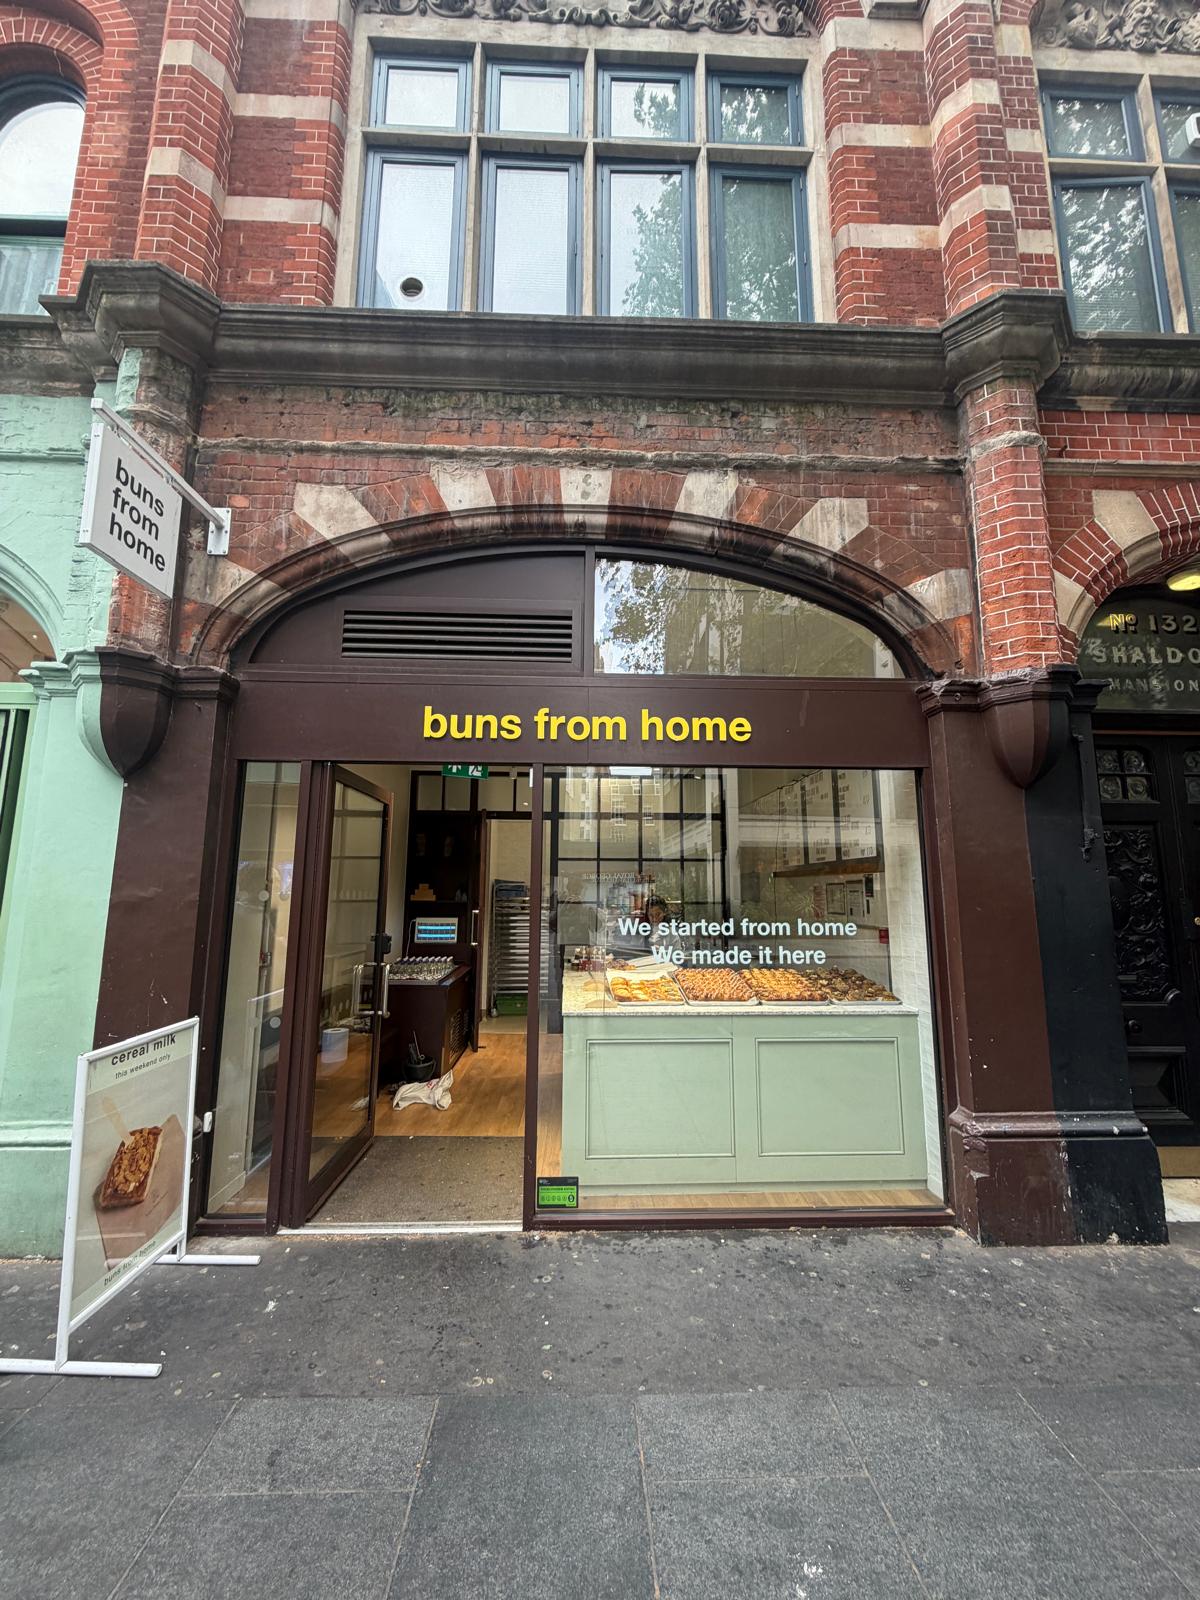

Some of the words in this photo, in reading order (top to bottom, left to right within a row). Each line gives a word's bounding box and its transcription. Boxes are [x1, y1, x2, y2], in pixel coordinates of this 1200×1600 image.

[116, 457, 165, 517] buns
[112, 487, 159, 541] from
[109, 512, 166, 572] home
[1148, 614, 1199, 634] 132
[423, 705, 522, 740] buns
[533, 707, 627, 741] from
[640, 708, 753, 742] home
[618, 918, 652, 936] We
[658, 918, 735, 936] started
[740, 918, 791, 936] from
[797, 918, 857, 936] home
[651, 946, 685, 964] We
[691, 946, 752, 964] made
[758, 946, 773, 964] it
[778, 946, 826, 964] here
[111, 1042, 149, 1066] cereal
[153, 1032, 176, 1051] milk
[115, 1069, 128, 1079] this
[130, 1057, 158, 1073] weekend
[158, 1052, 171, 1063] only
